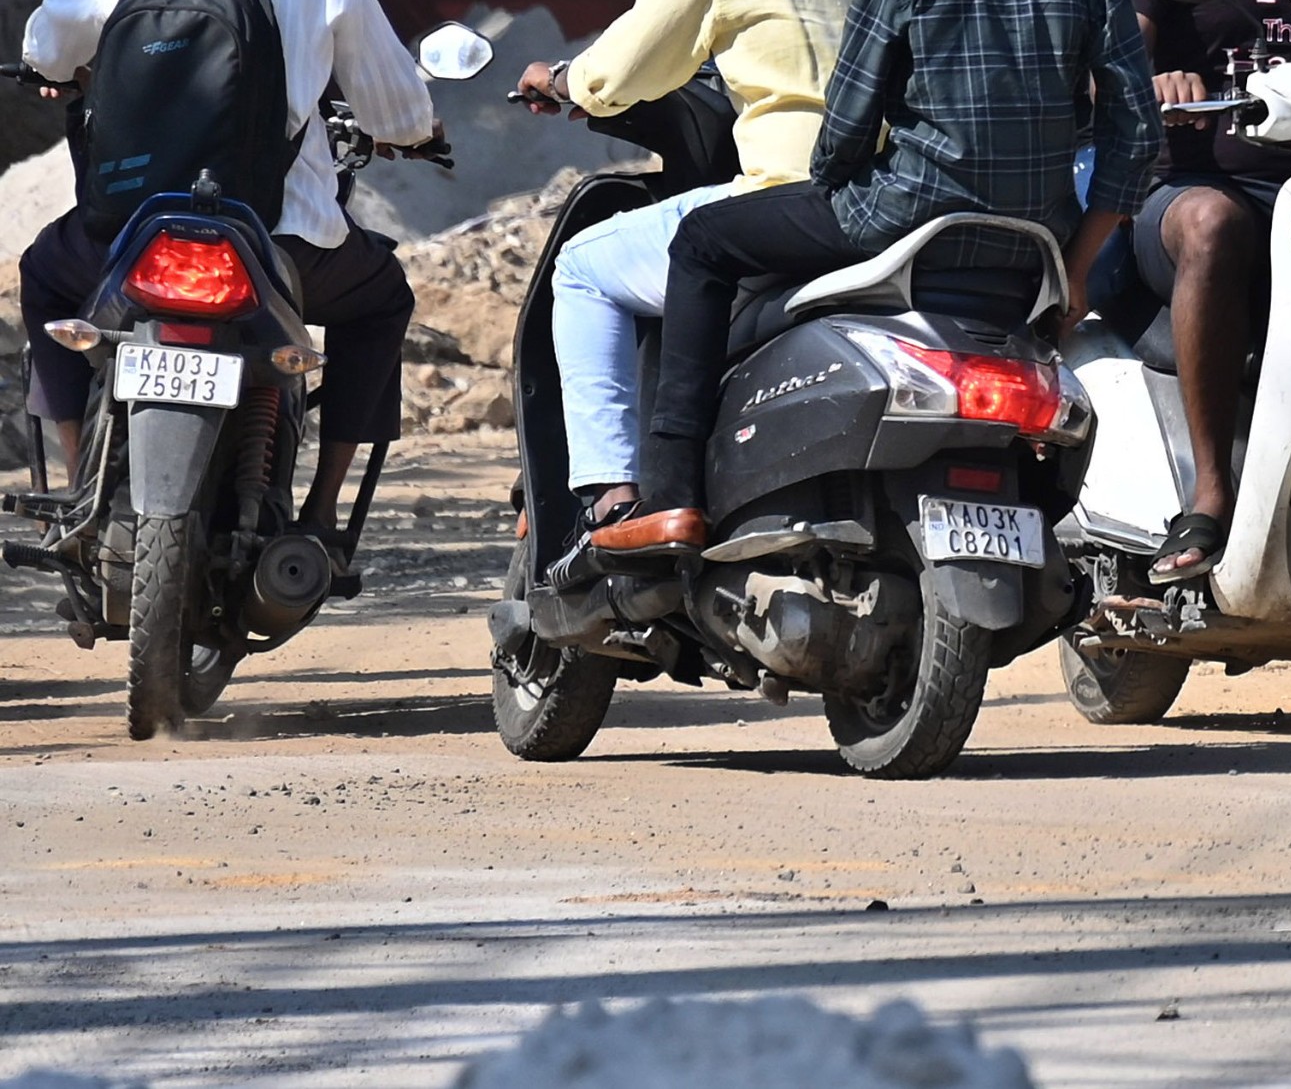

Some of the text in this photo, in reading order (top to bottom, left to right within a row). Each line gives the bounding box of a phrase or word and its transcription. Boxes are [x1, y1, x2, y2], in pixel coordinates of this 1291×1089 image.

[140, 348, 220, 377] KA03J
[137, 374, 216, 401] Z5913
[944, 502, 1020, 532] KA03K
[949, 529, 1024, 561] C8201
